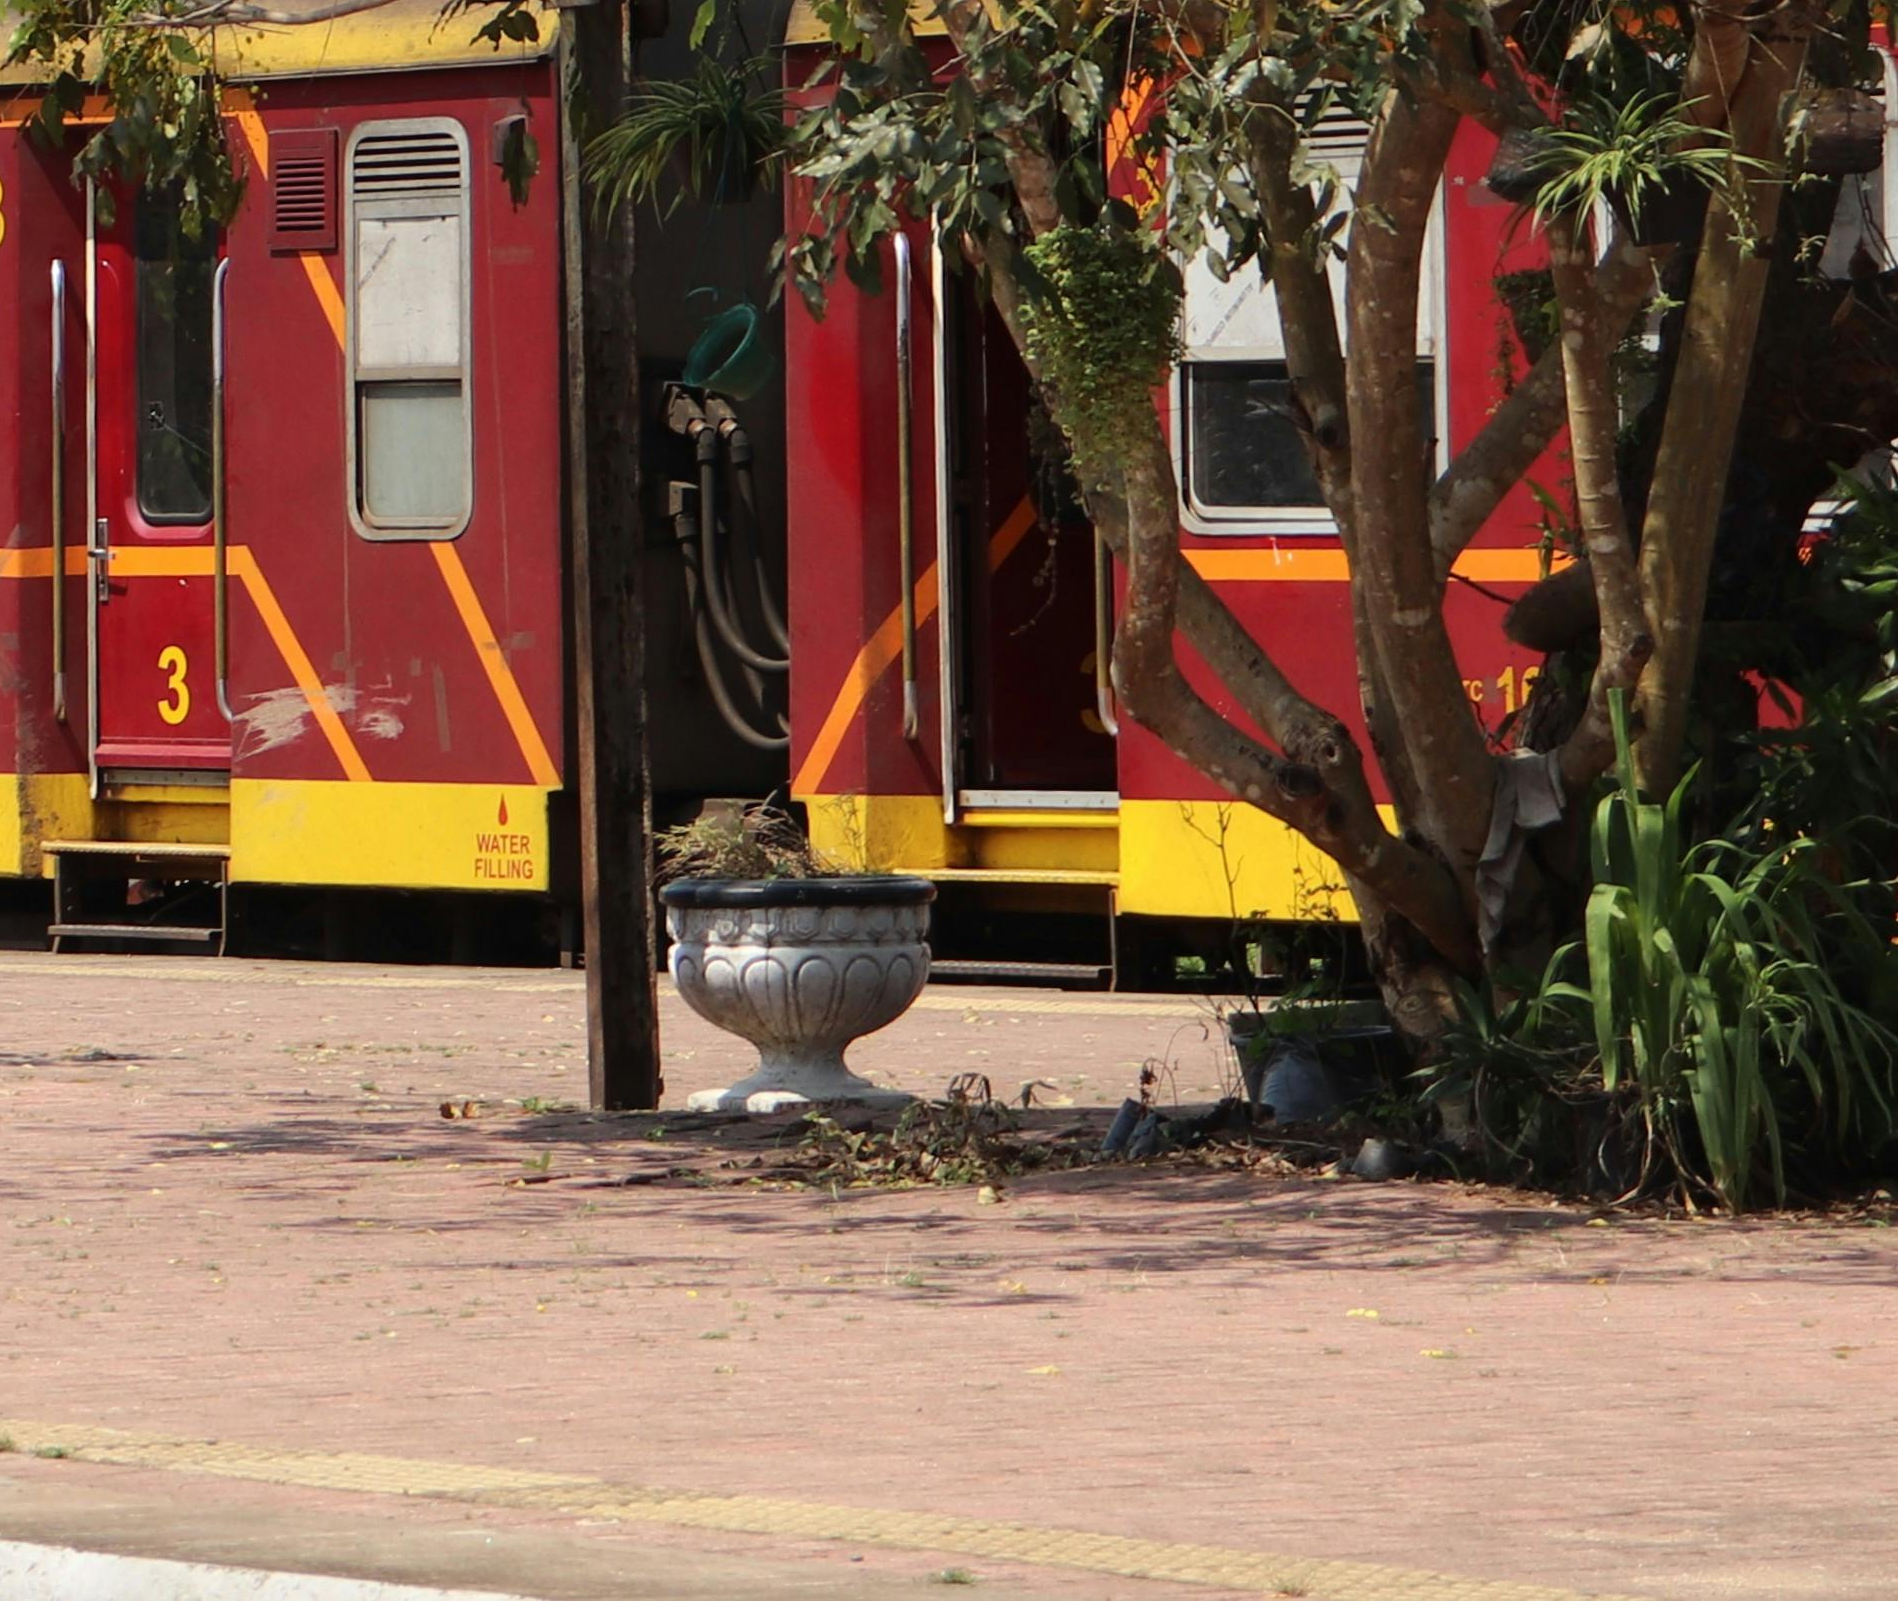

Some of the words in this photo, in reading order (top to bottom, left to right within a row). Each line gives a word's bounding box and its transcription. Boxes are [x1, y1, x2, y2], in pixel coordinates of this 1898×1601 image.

[158, 645, 190, 725] 3
[476, 833, 531, 855] WATER
[474, 858, 534, 880] FILLING
